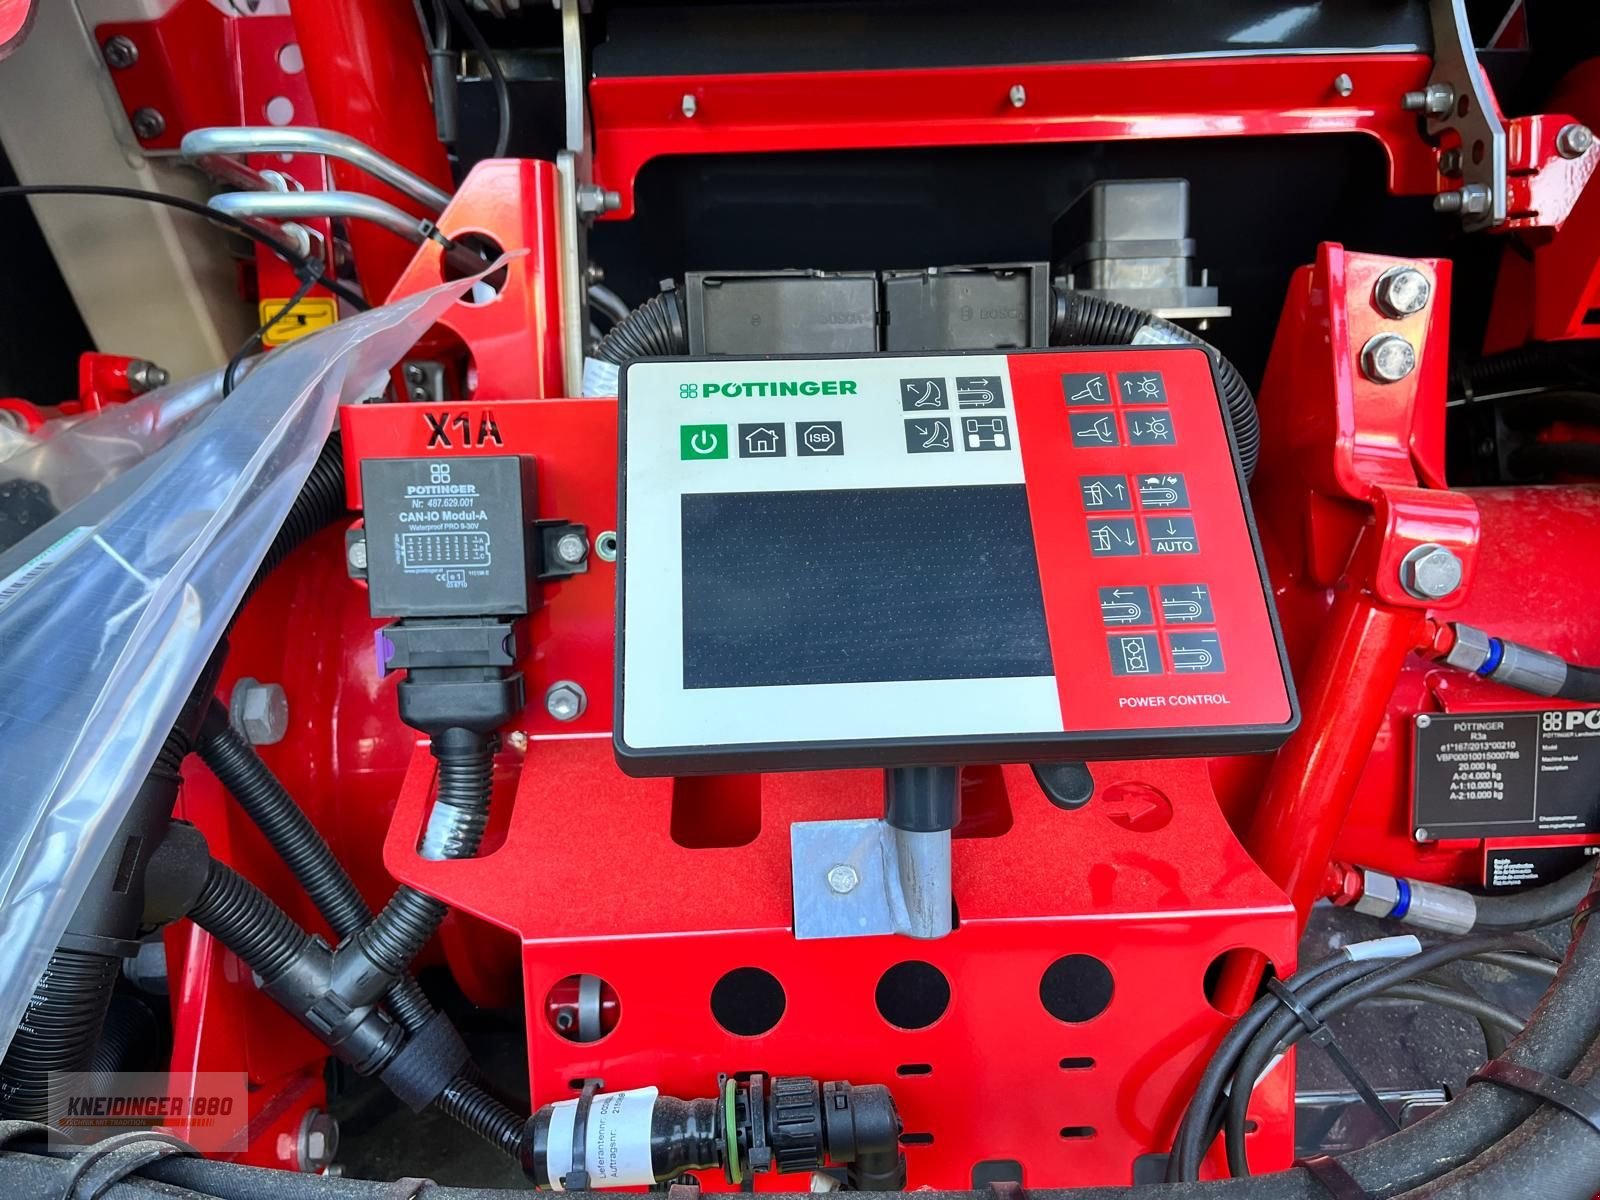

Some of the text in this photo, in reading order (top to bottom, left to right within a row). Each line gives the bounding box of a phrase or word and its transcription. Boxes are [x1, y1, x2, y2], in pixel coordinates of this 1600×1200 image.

[423, 408, 504, 449] X1A
[809, 433, 831, 443] ISB
[399, 510, 488, 522] CAN-IO Modul-A
[1156, 541, 1193, 552] AUTO
[1119, 694, 1231, 708] POWER CONTROL
[1470, 732, 1487, 741] R3a
[1458, 762, 1497, 771] 20.000 kg
[1492, 771, 1502, 781] kg
[1493, 781, 1504, 790] kg
[1493, 791, 1503, 800] kg
